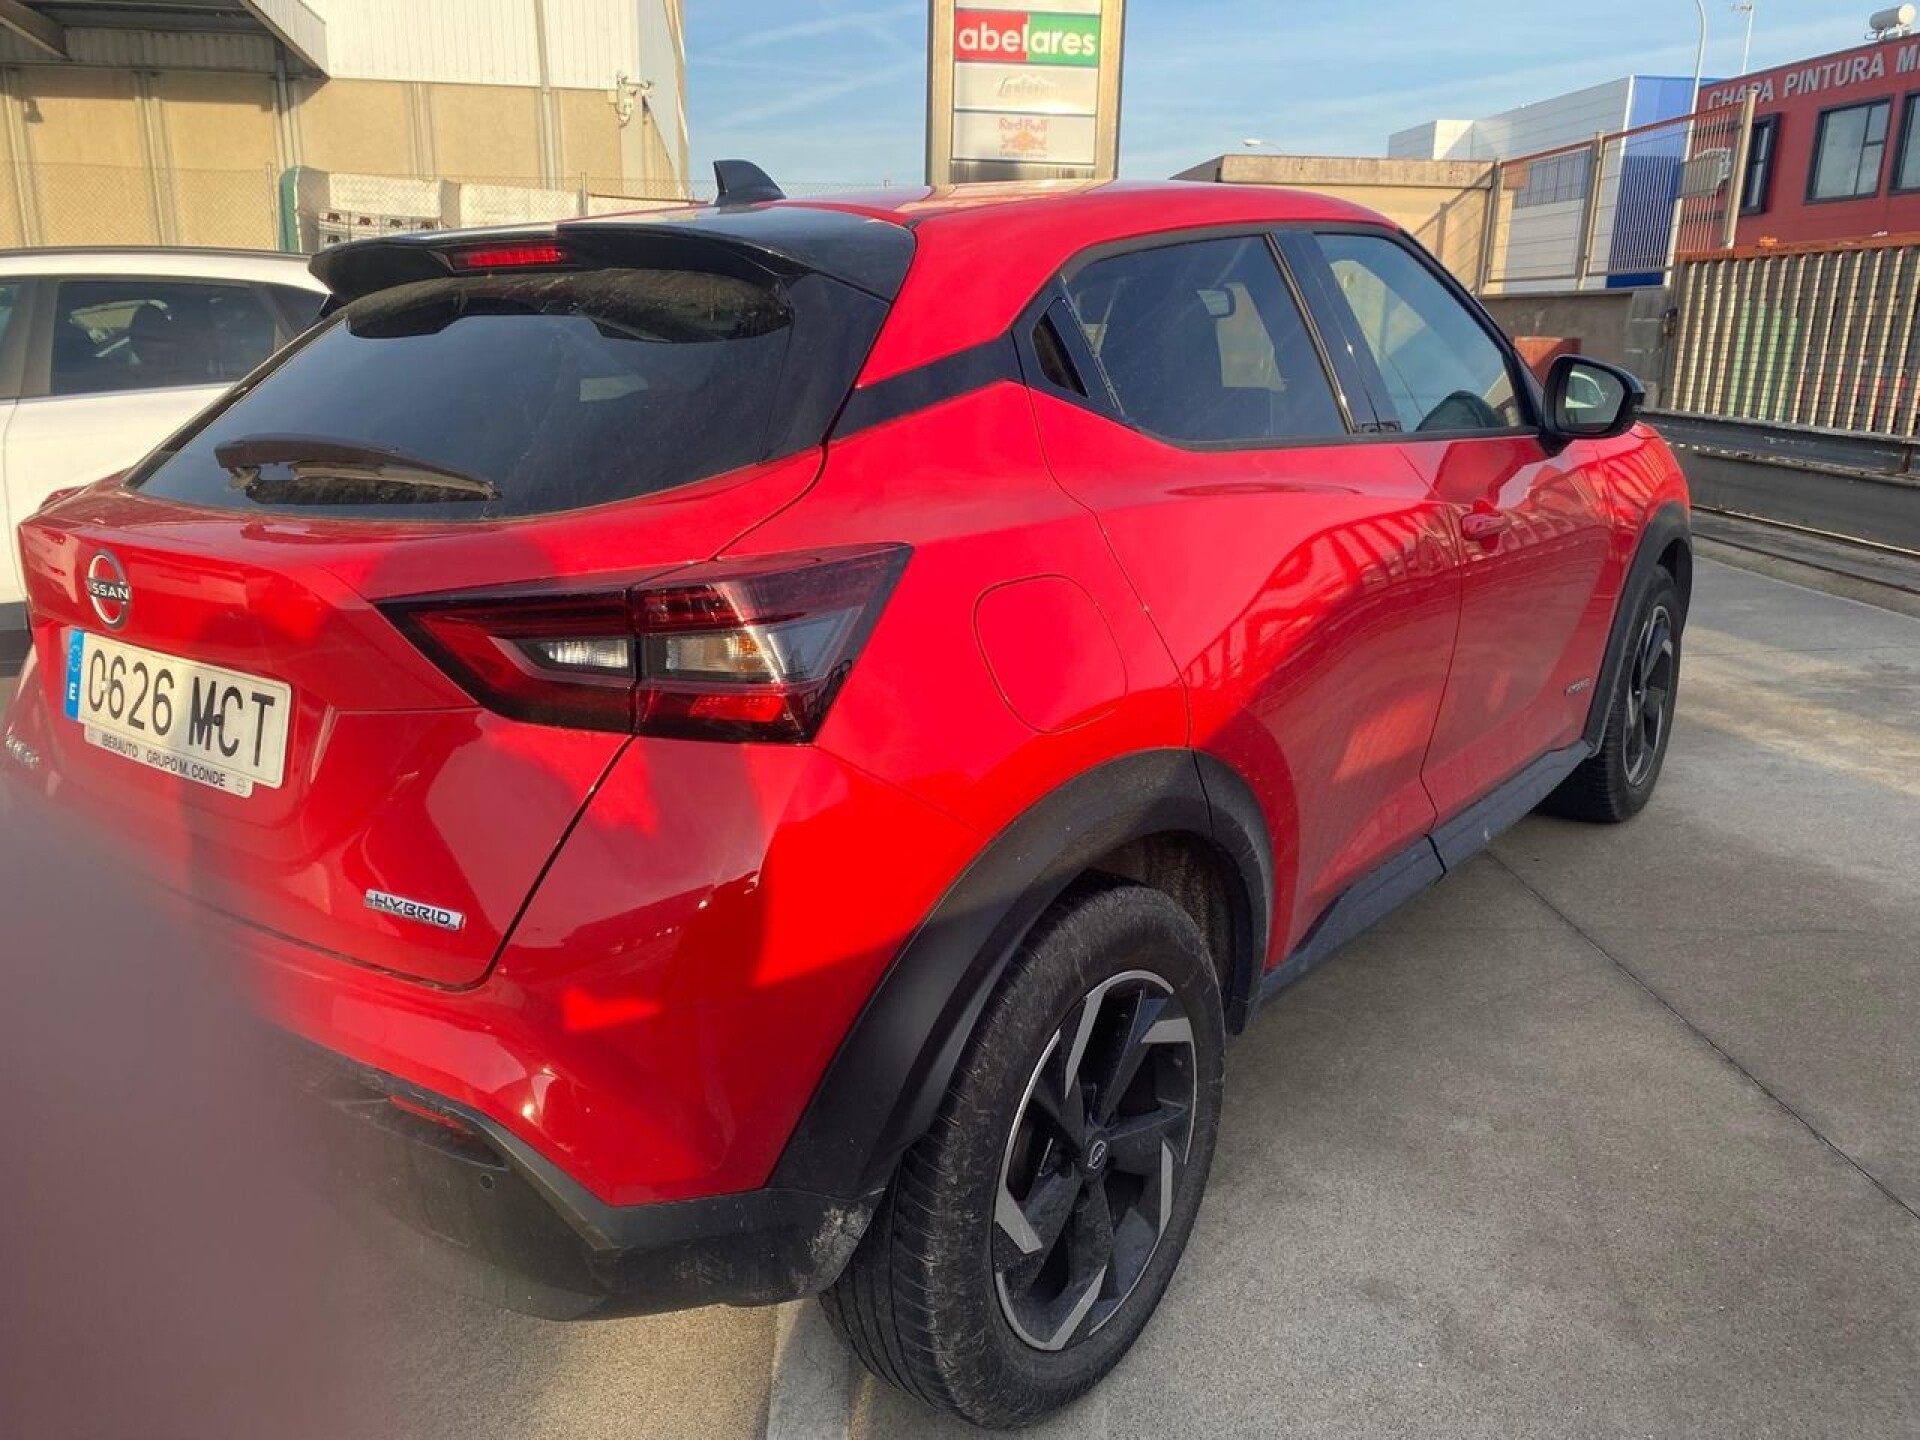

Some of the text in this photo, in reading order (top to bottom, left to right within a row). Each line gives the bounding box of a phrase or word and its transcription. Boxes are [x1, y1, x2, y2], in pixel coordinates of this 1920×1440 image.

[958, 22, 1096, 56] abelares
[1783, 52, 1885, 97] PINTURA
[188, 675, 276, 767] MCT
[101, 733, 139, 757] IBERAUTO
[146, 750, 178, 772] GRUPO
[191, 764, 226, 787] CONDE
[374, 893, 451, 925] HYBRID
